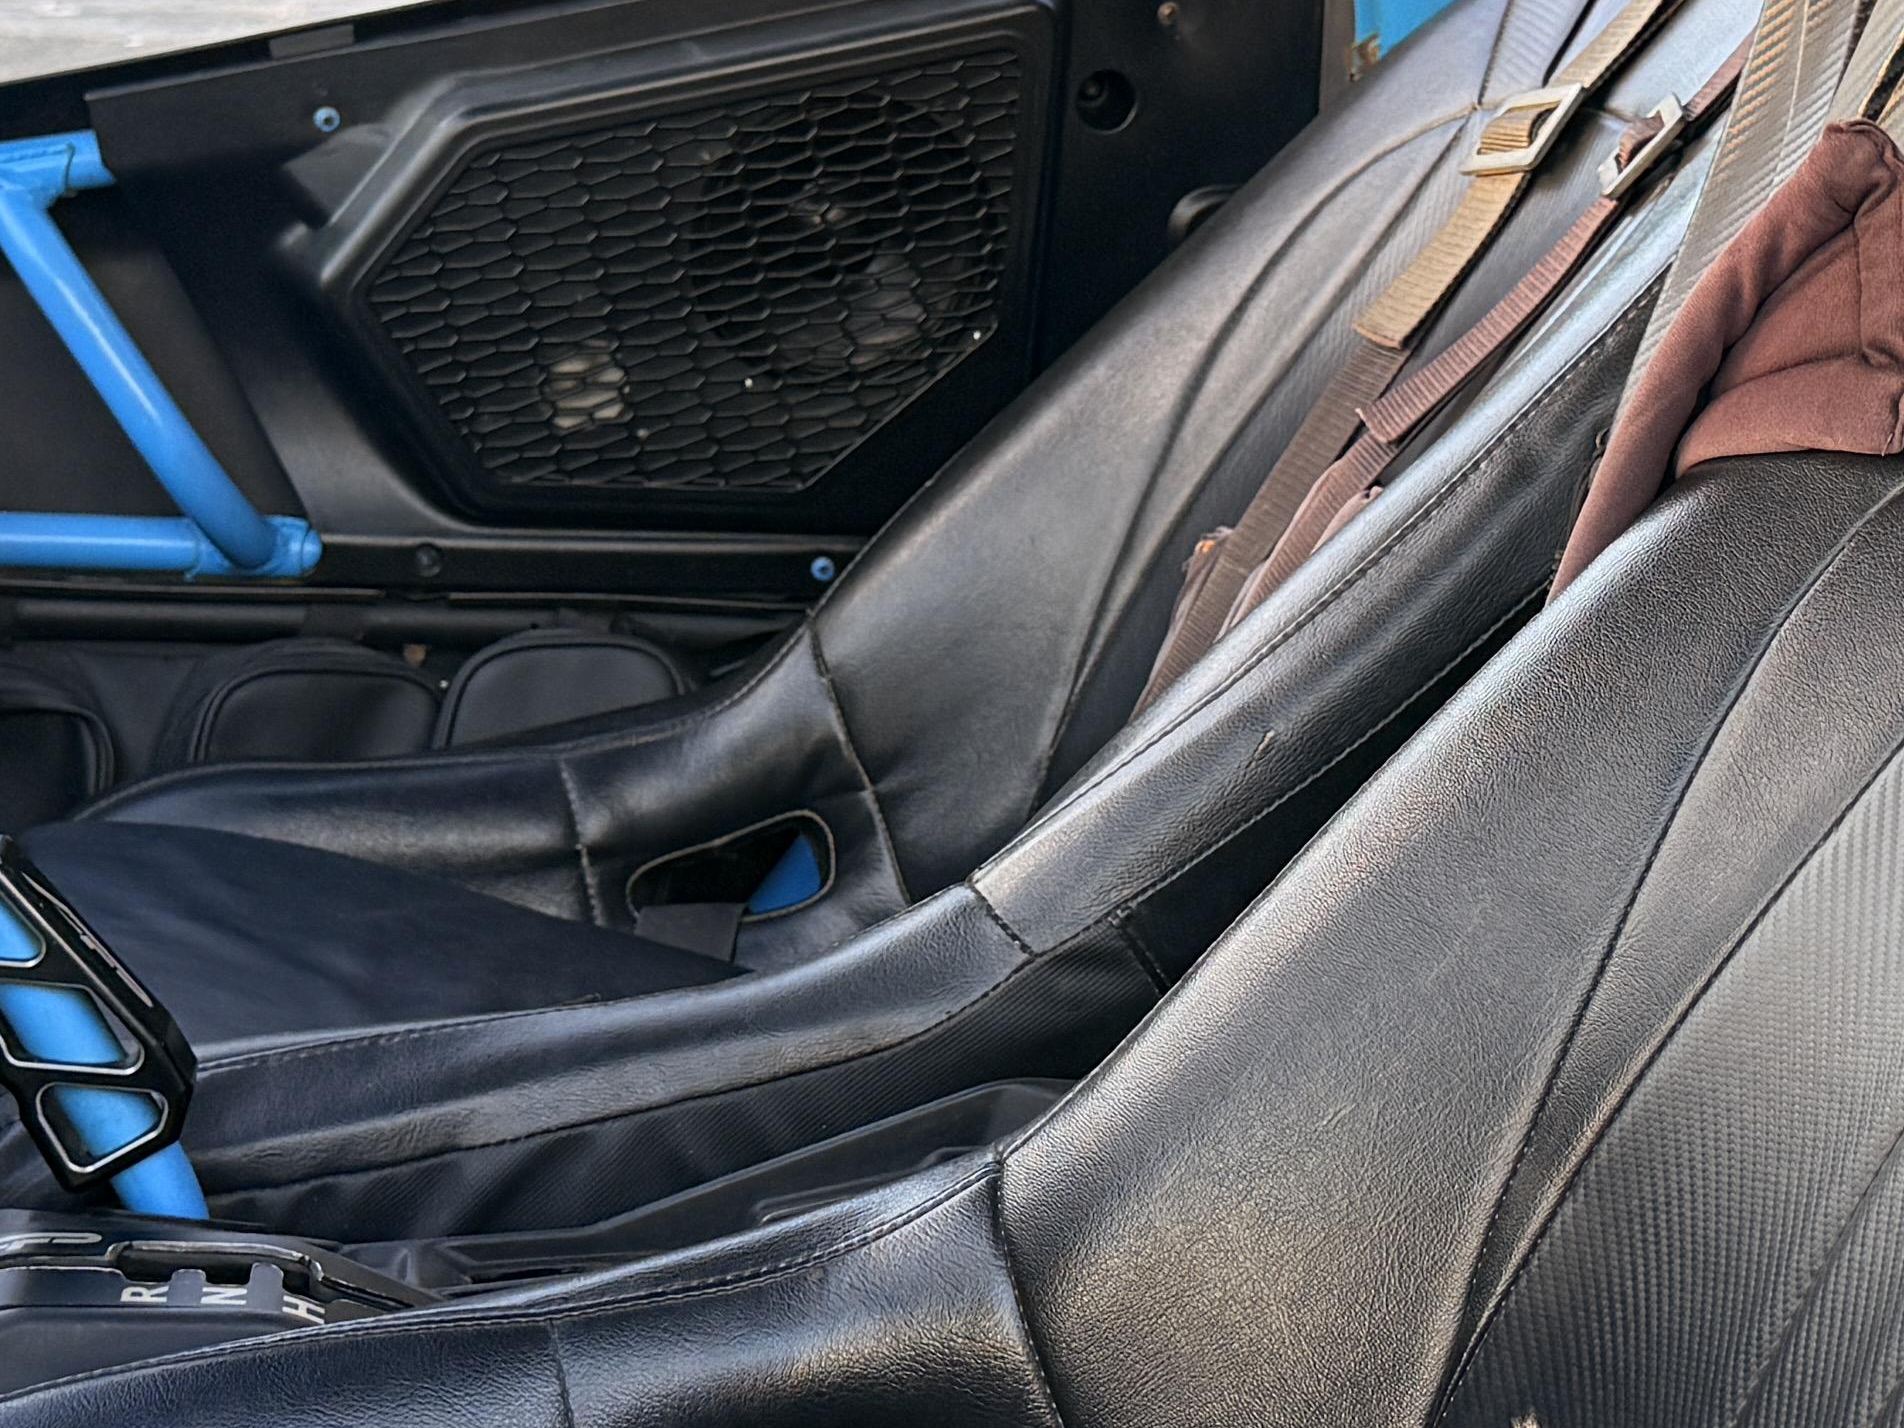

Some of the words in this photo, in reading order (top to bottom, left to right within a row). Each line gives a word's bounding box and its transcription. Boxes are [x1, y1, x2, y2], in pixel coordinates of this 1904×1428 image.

[119, 1285, 170, 1303] R
[200, 1286, 248, 1306] N
[281, 1294, 326, 1325] H
